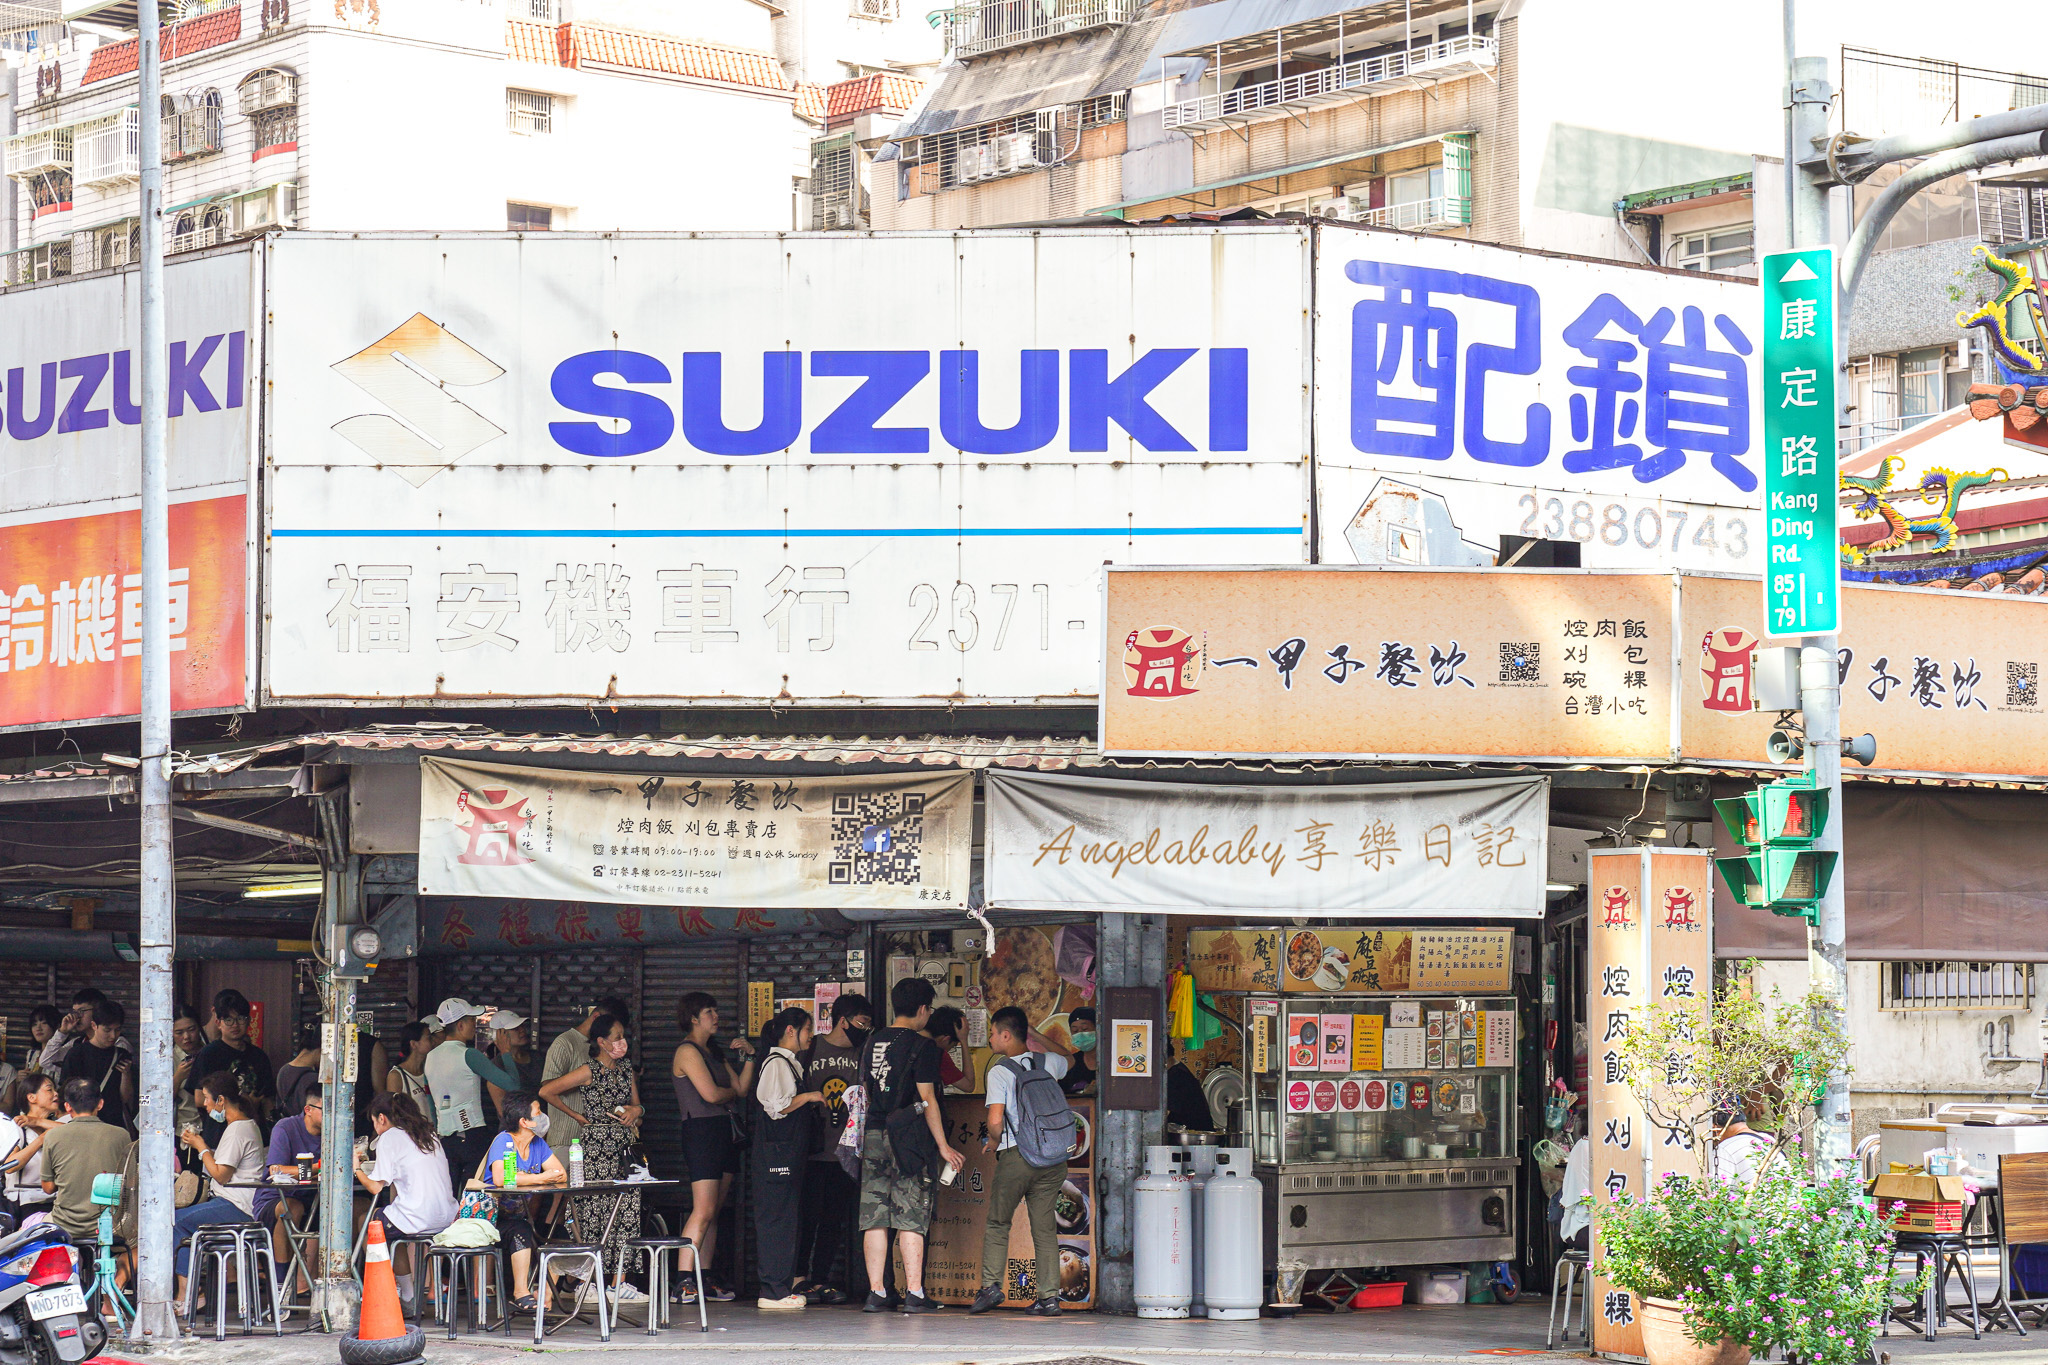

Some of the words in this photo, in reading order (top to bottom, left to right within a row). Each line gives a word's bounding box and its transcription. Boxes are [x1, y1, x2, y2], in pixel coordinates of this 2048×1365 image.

[0, 331, 244, 440] UZUKI
[1345, 260, 1758, 491] 配鎖
[1780, 297, 1818, 477] 康定路
[549, 348, 1248, 457] SUZUKI
[1771, 491, 1818, 513] Kang
[1519, 495, 1748, 559] 23880743
[1772, 518, 1813, 543] Ding
[1772, 545, 1801, 563] Rd.
[1774, 575, 1794, 594] 85
[327, 563, 849, 653] 福安機車行
[1775, 608, 1795, 627] 79
[1563, 619, 1648, 639] 焢肉飯
[1183, 645, 1193, 681] 台灣小吃
[1211, 639, 1475, 689] 一甲子餐飲
[1565, 695, 1648, 715] 台灣小吃
[588, 777, 803, 813] 一甲子餐飲
[616, 819, 674, 837] 焢肉飯
[684, 820, 778, 839] 刈包專賣店
[609, 844, 650, 857] 營業時間
[654, 847, 716, 857] 09:00-19:00
[743, 848, 784, 859] 週日公休
[787, 850, 819, 862] Sunday
[1033, 824, 1288, 878] Angelababy
[1294, 818, 1526, 872] 享樂日記
[609, 866, 651, 878] 訂餐專線
[654, 869, 722, 879] 02-2311-5241
[918, 888, 952, 901] 康定店
